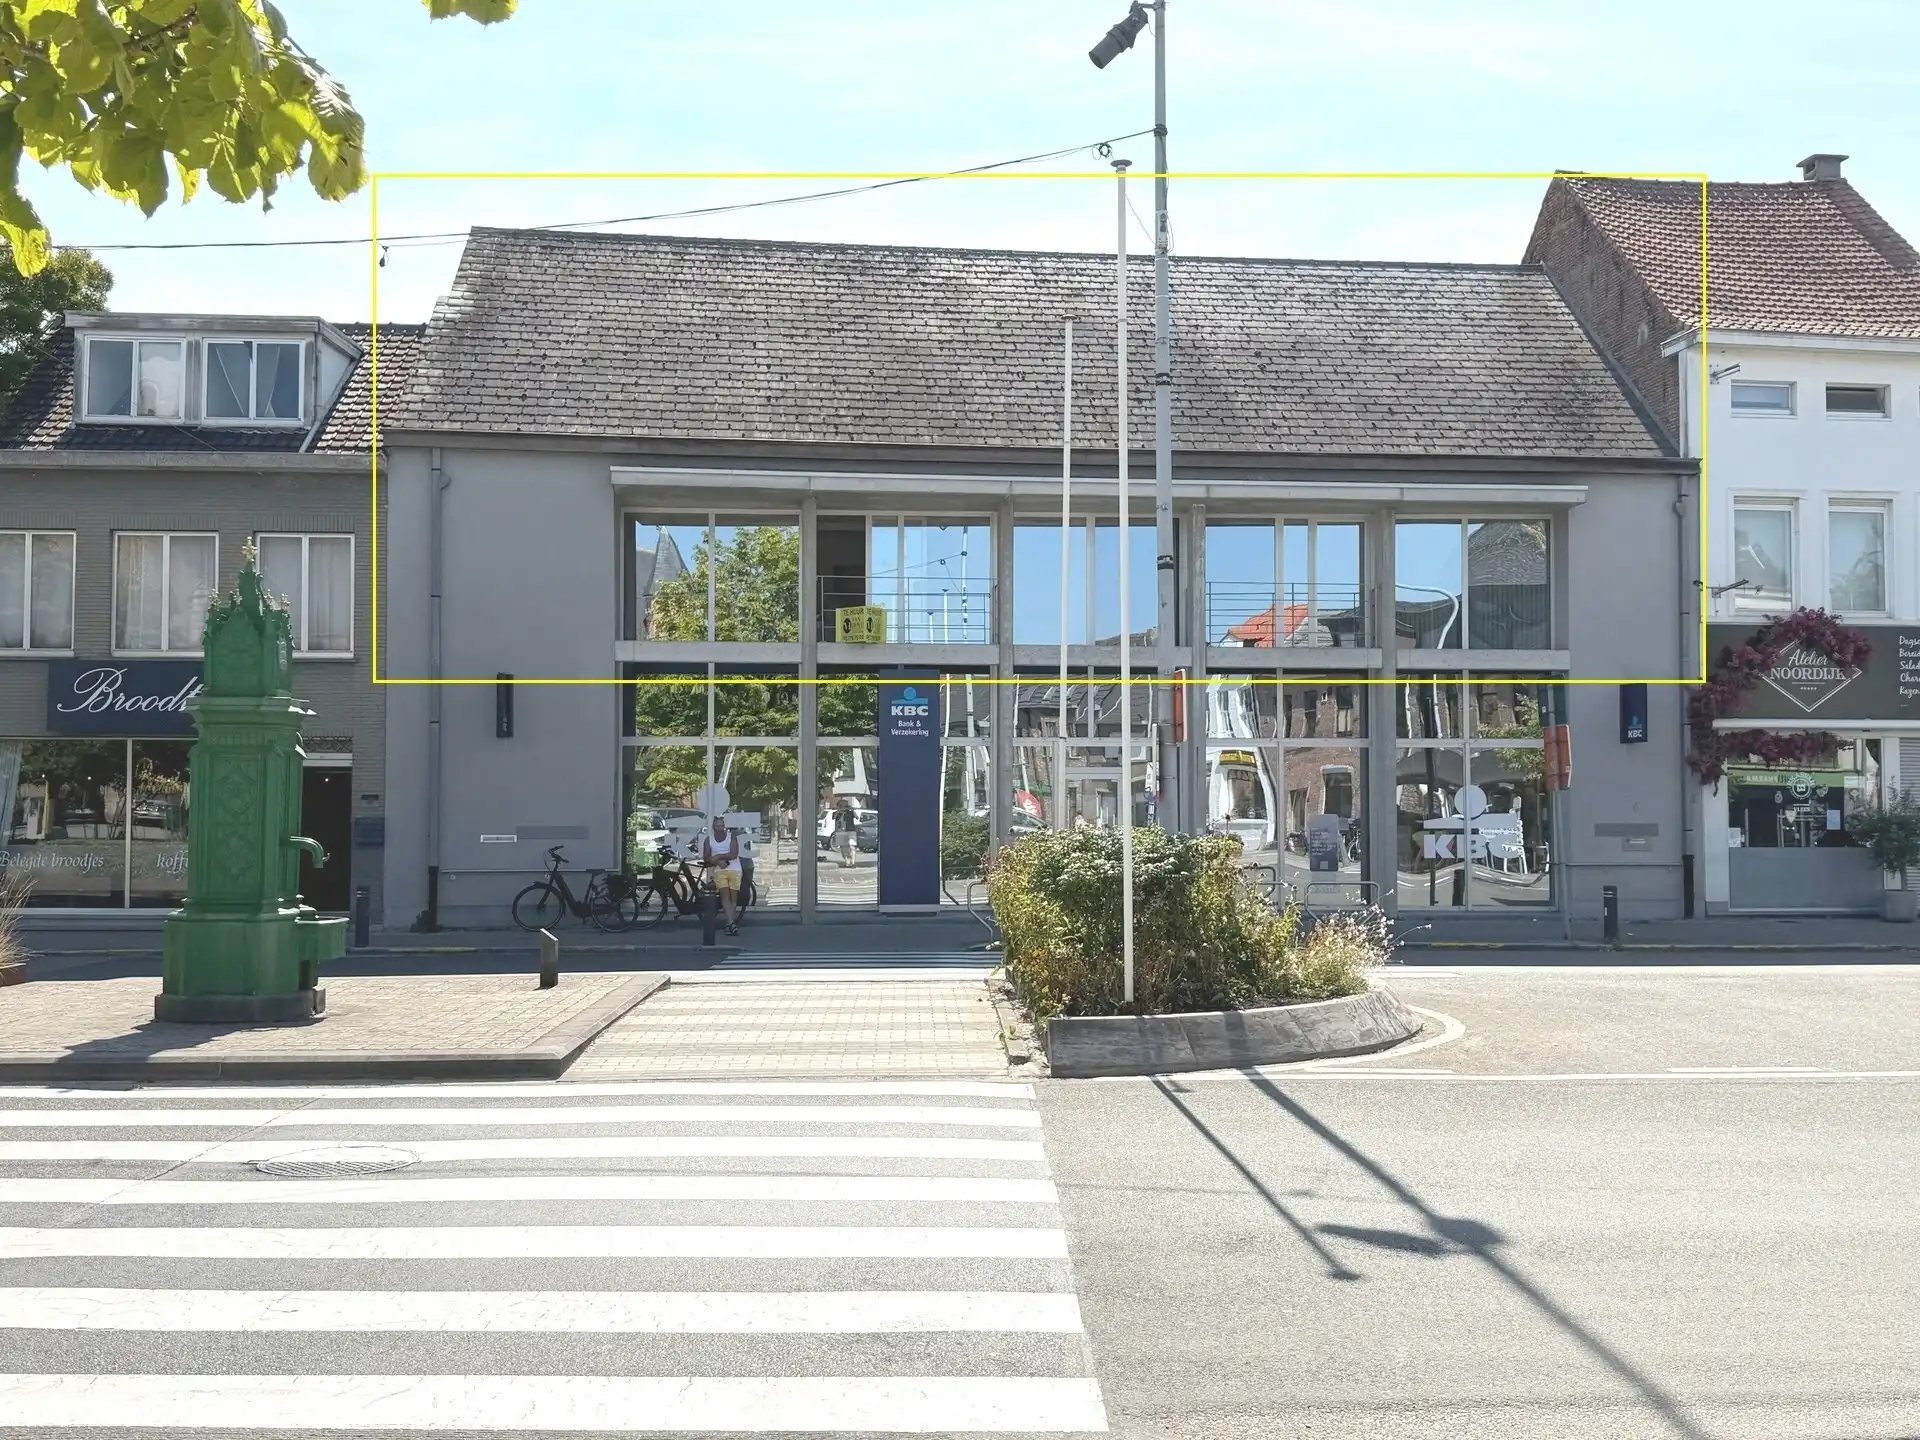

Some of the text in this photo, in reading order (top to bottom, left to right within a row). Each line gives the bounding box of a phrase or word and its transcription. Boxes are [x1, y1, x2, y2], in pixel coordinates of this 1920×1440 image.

[1788, 648, 1829, 667] Atelier
[1769, 667, 1846, 680] NOORDIJK
[891, 705, 929, 716] KBC
[891, 729, 929, 737] Verzekering
[1628, 729, 1642, 738] KBC
[1423, 834, 1520, 859] KBC
[0, 851, 104, 874] Belegde broodjes
